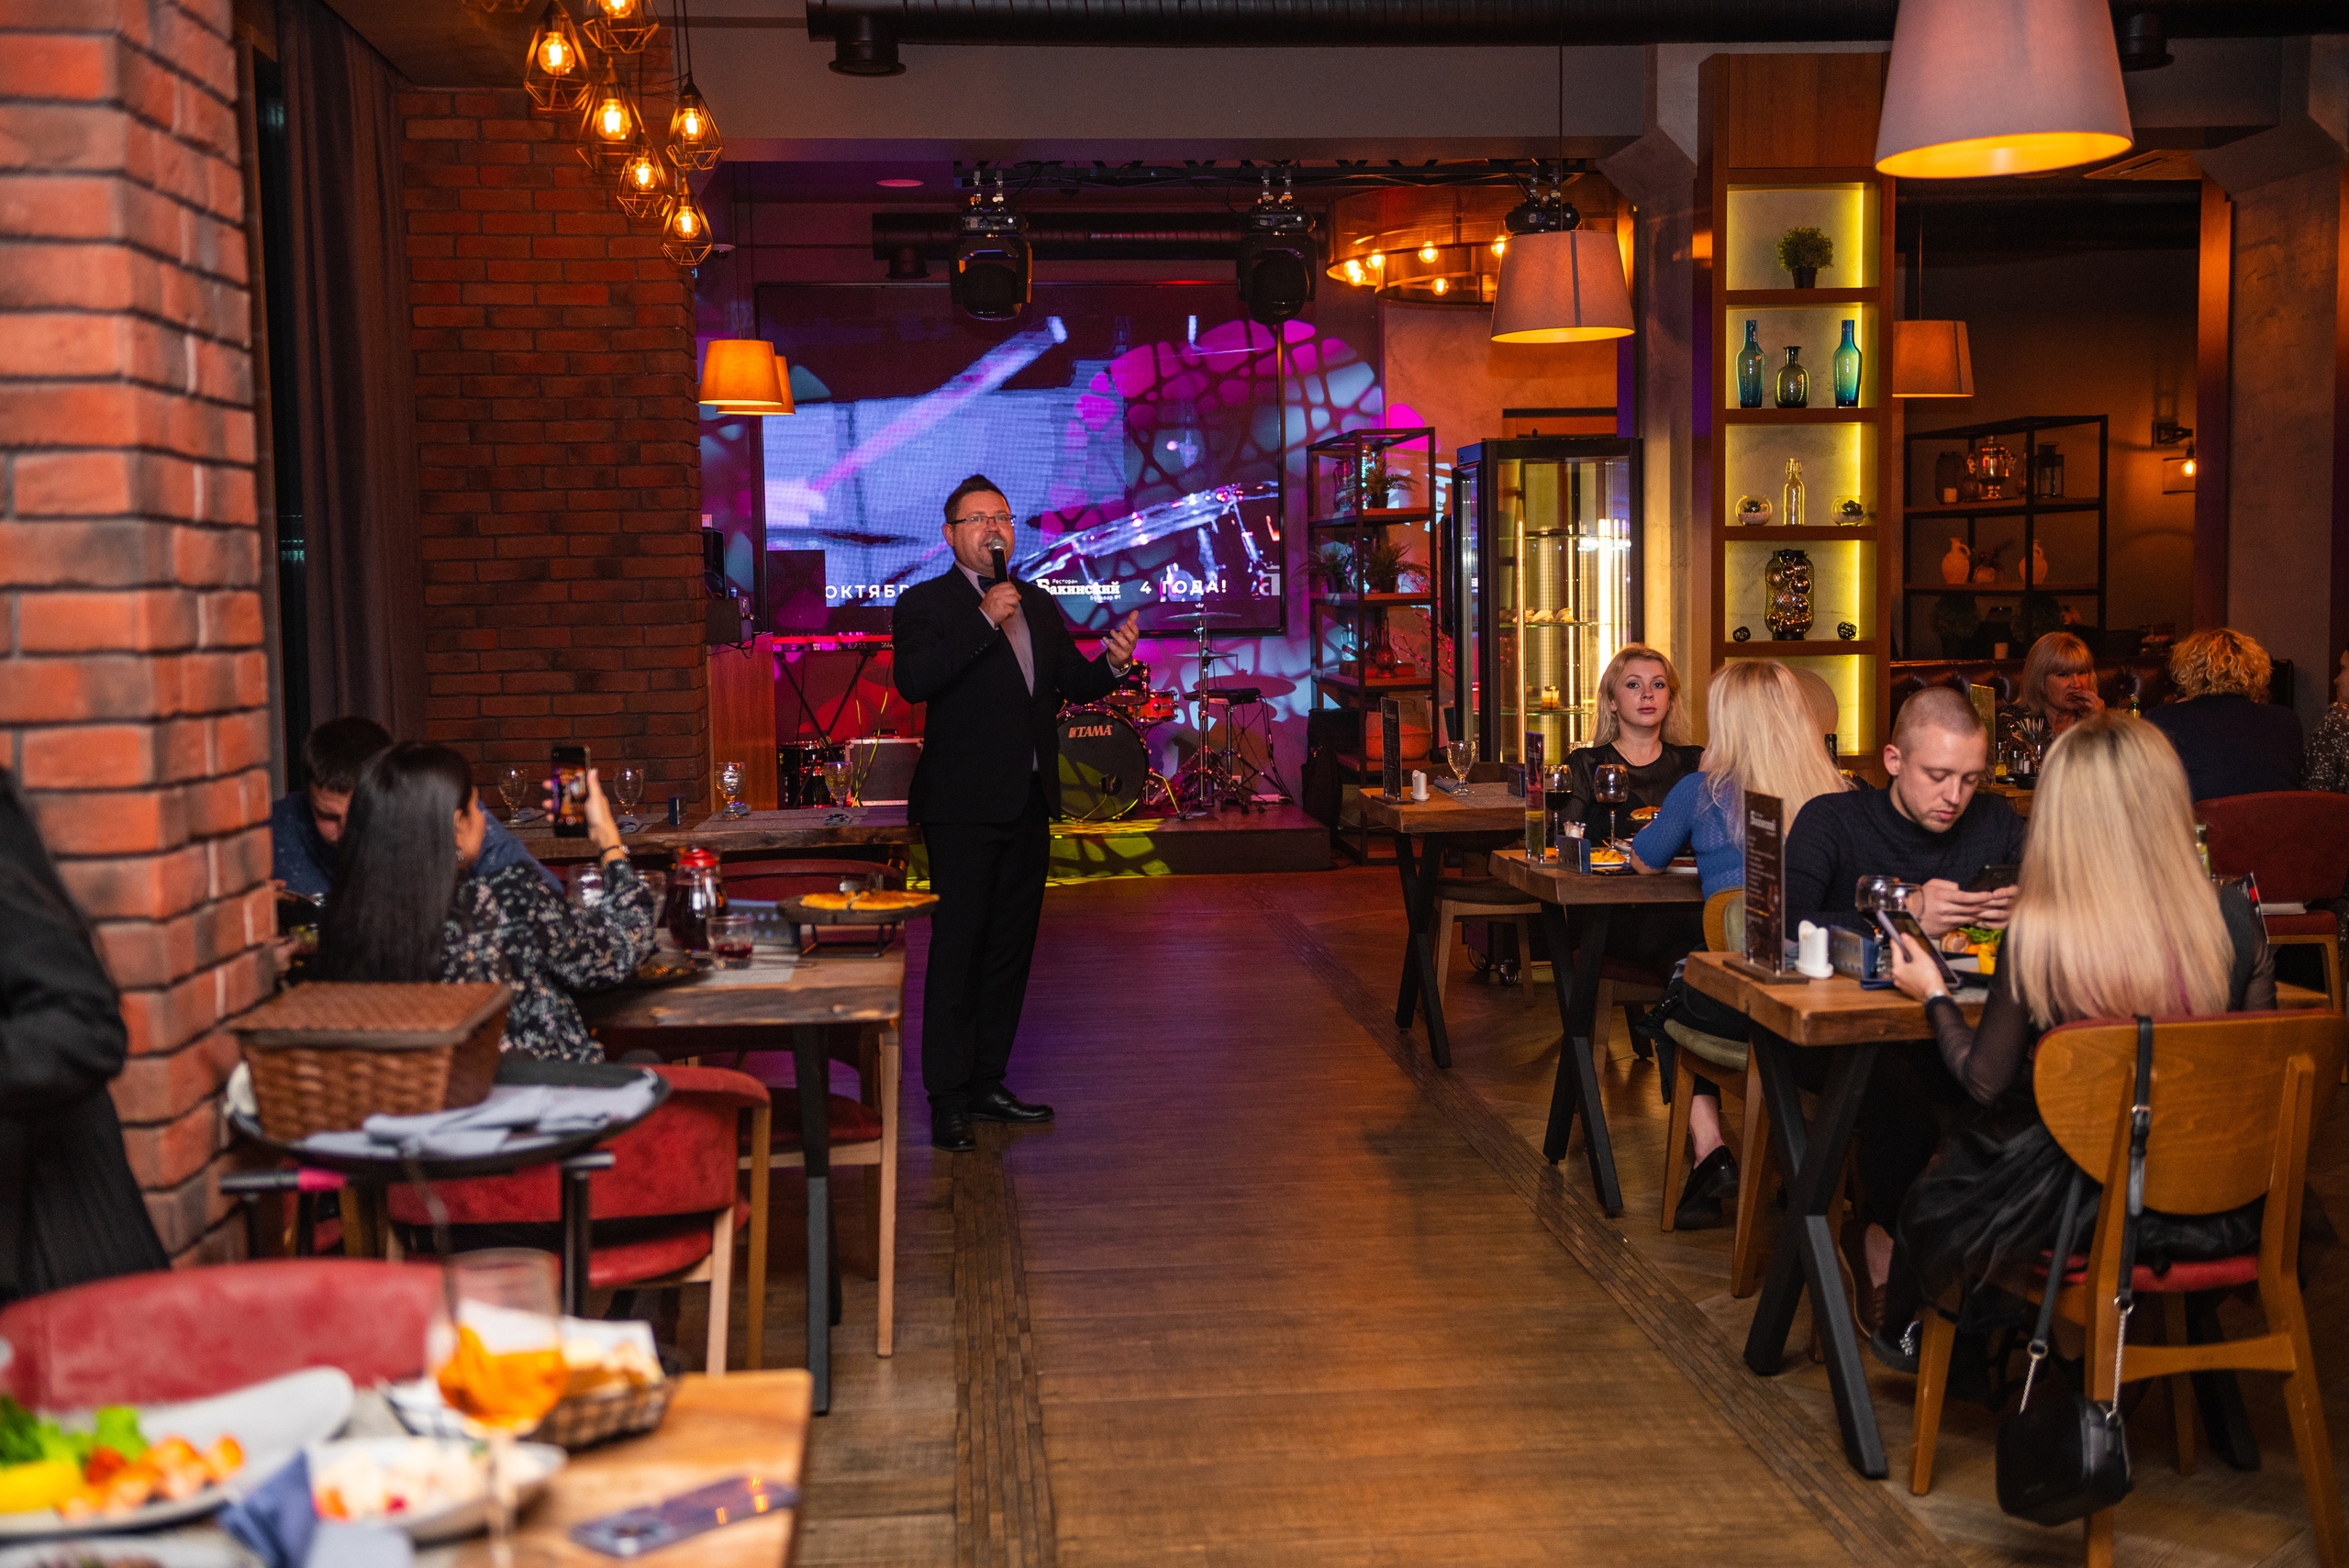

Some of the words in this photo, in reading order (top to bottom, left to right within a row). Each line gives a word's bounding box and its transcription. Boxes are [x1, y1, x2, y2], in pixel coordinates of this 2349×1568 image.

[1140, 581, 1152, 594] 4
[1162, 580, 1227, 595] ГОДА!
[1076, 725, 1113, 738] TAMA
